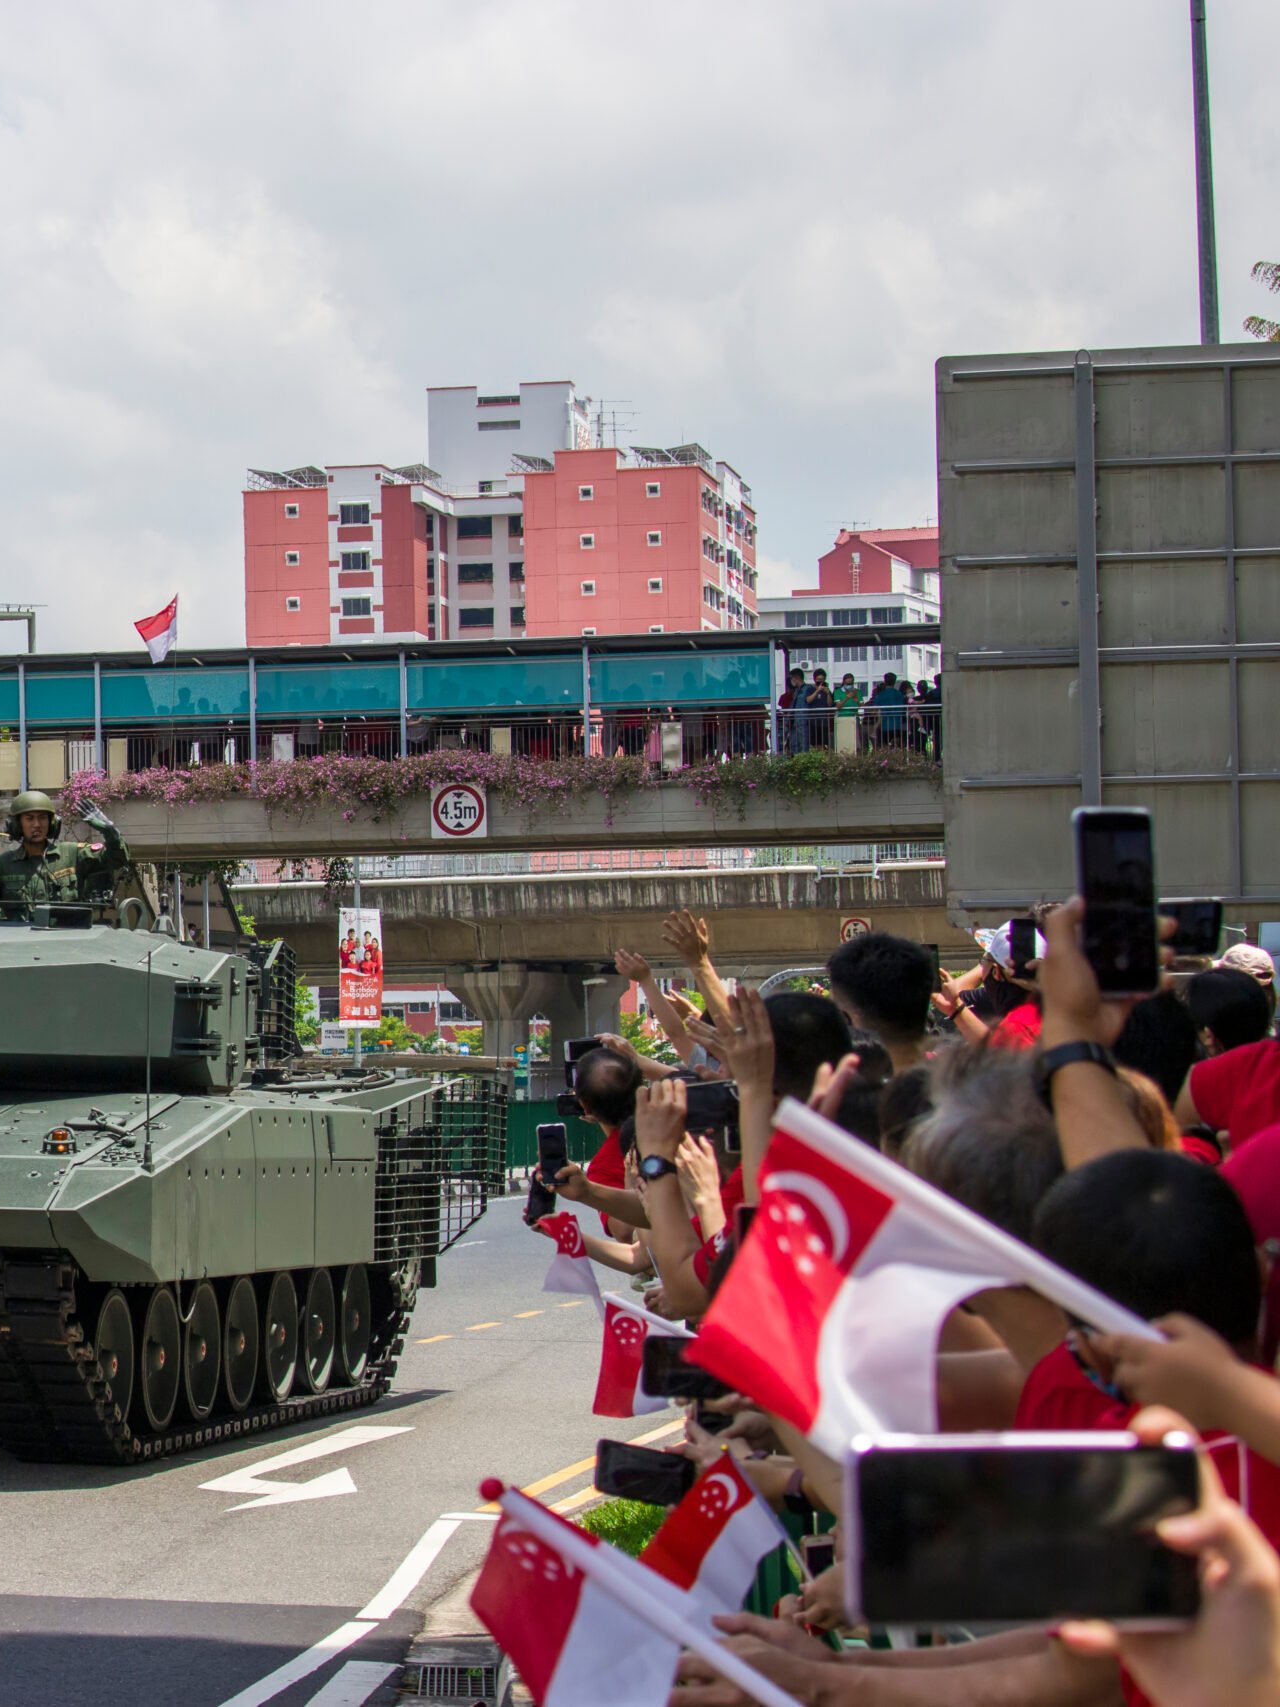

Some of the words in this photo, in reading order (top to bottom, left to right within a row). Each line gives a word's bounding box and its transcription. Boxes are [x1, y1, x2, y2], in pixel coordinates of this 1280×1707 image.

[440, 801, 477, 820] 4.5m
[346, 979, 363, 988] Happy
[342, 989, 376, 1000] Singapore
[350, 985, 379, 995] Birthday
